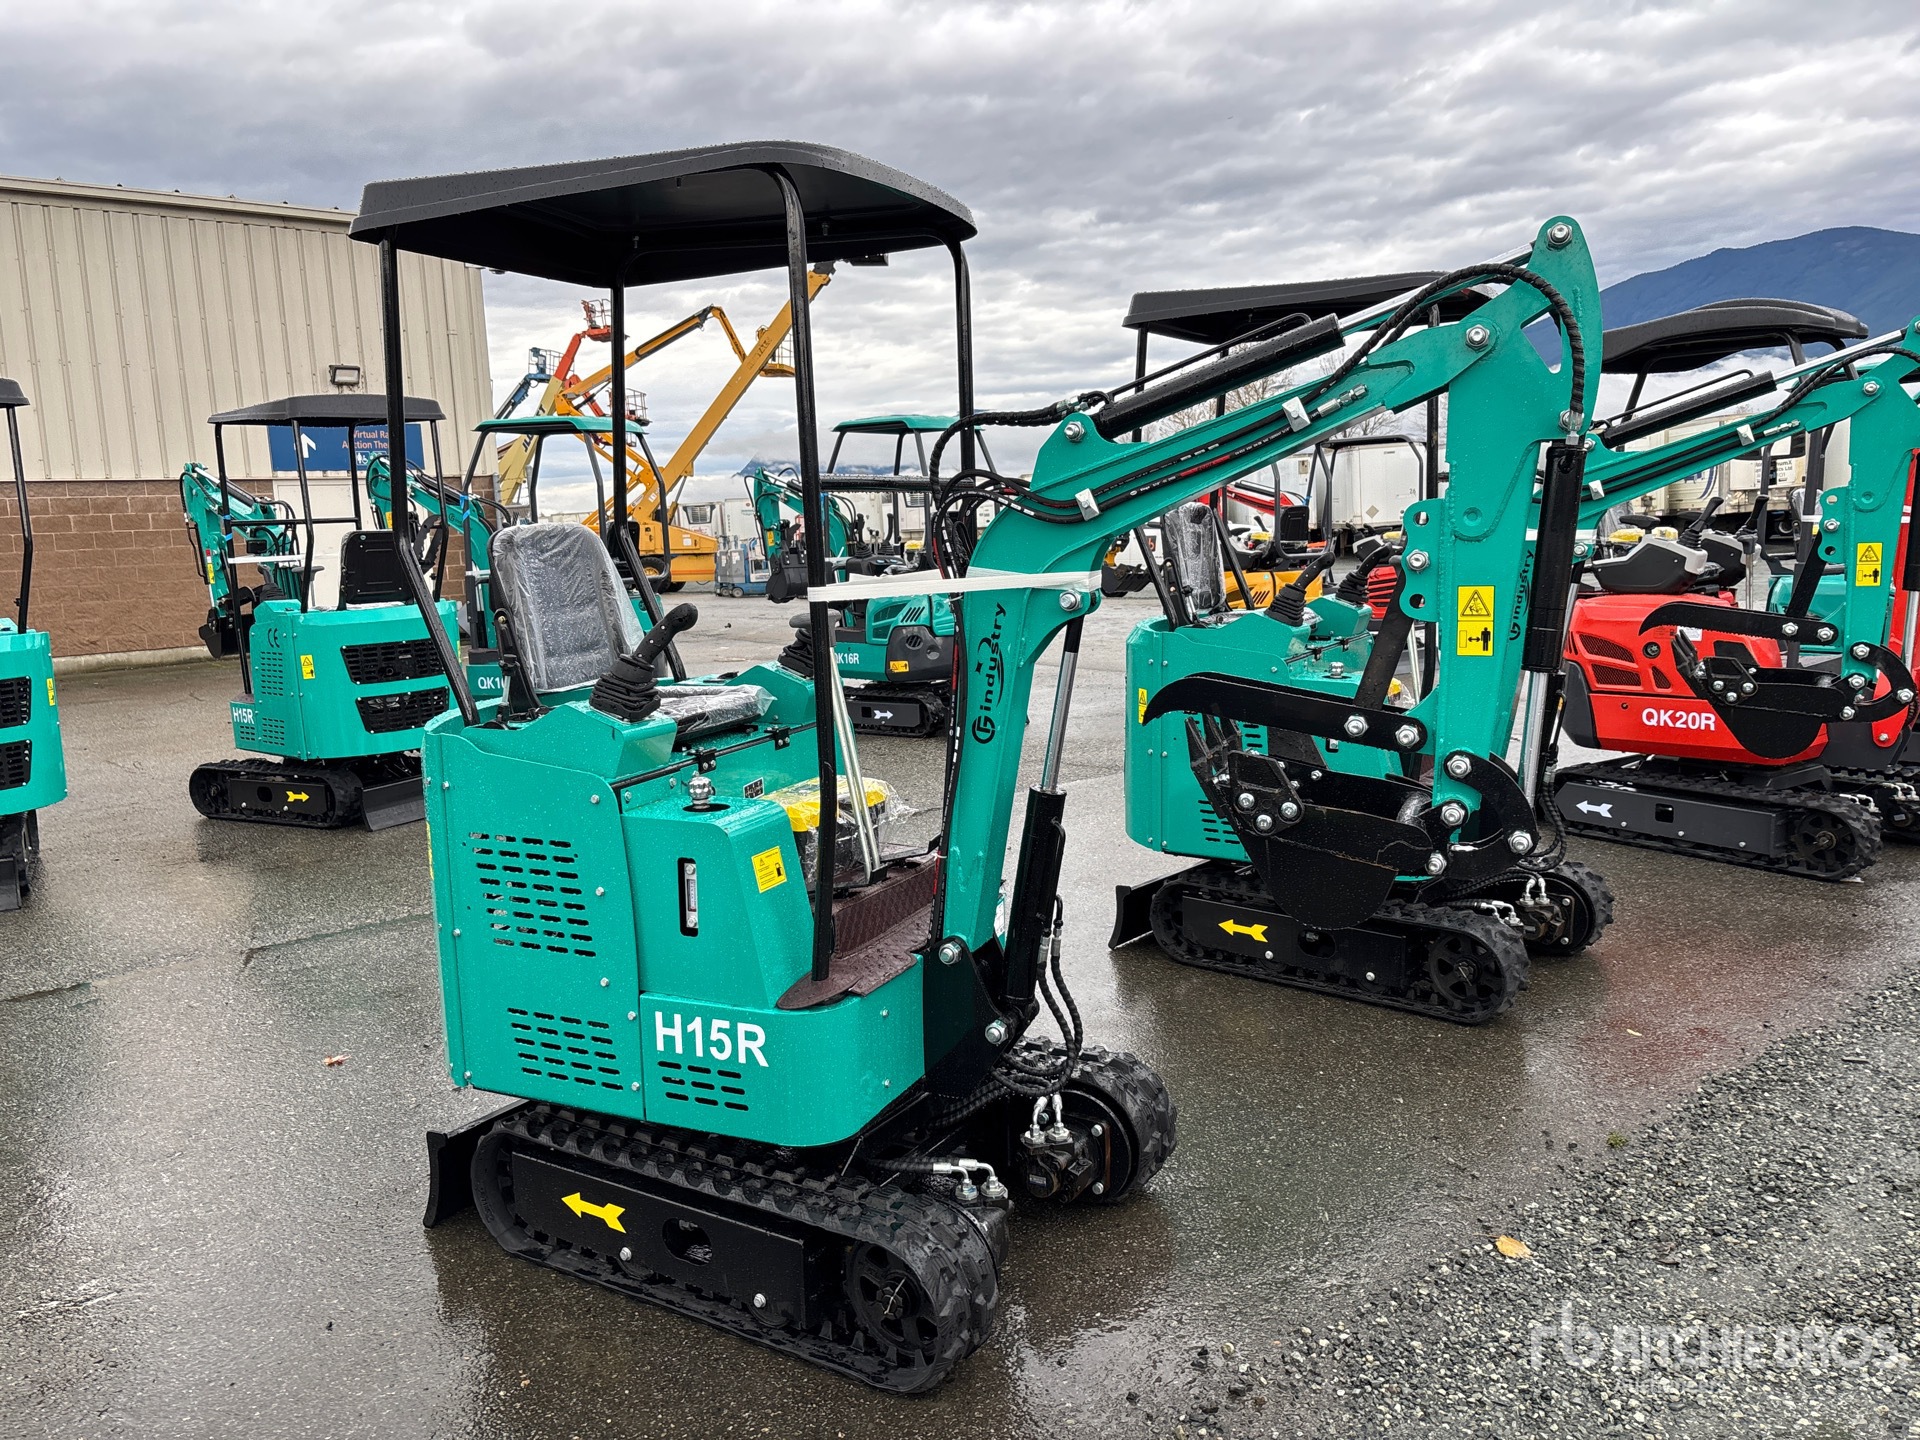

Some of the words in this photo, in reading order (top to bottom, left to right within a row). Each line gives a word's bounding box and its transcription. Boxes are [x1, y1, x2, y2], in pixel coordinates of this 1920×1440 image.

[354, 430, 378, 439] Virtual
[380, 430, 389, 439] Ra
[342, 440, 372, 449] Action
[373, 440, 389, 449] The
[232, 707, 255, 724] H15R
[1641, 707, 1716, 731] QK20R
[654, 1011, 770, 1067] H15R
